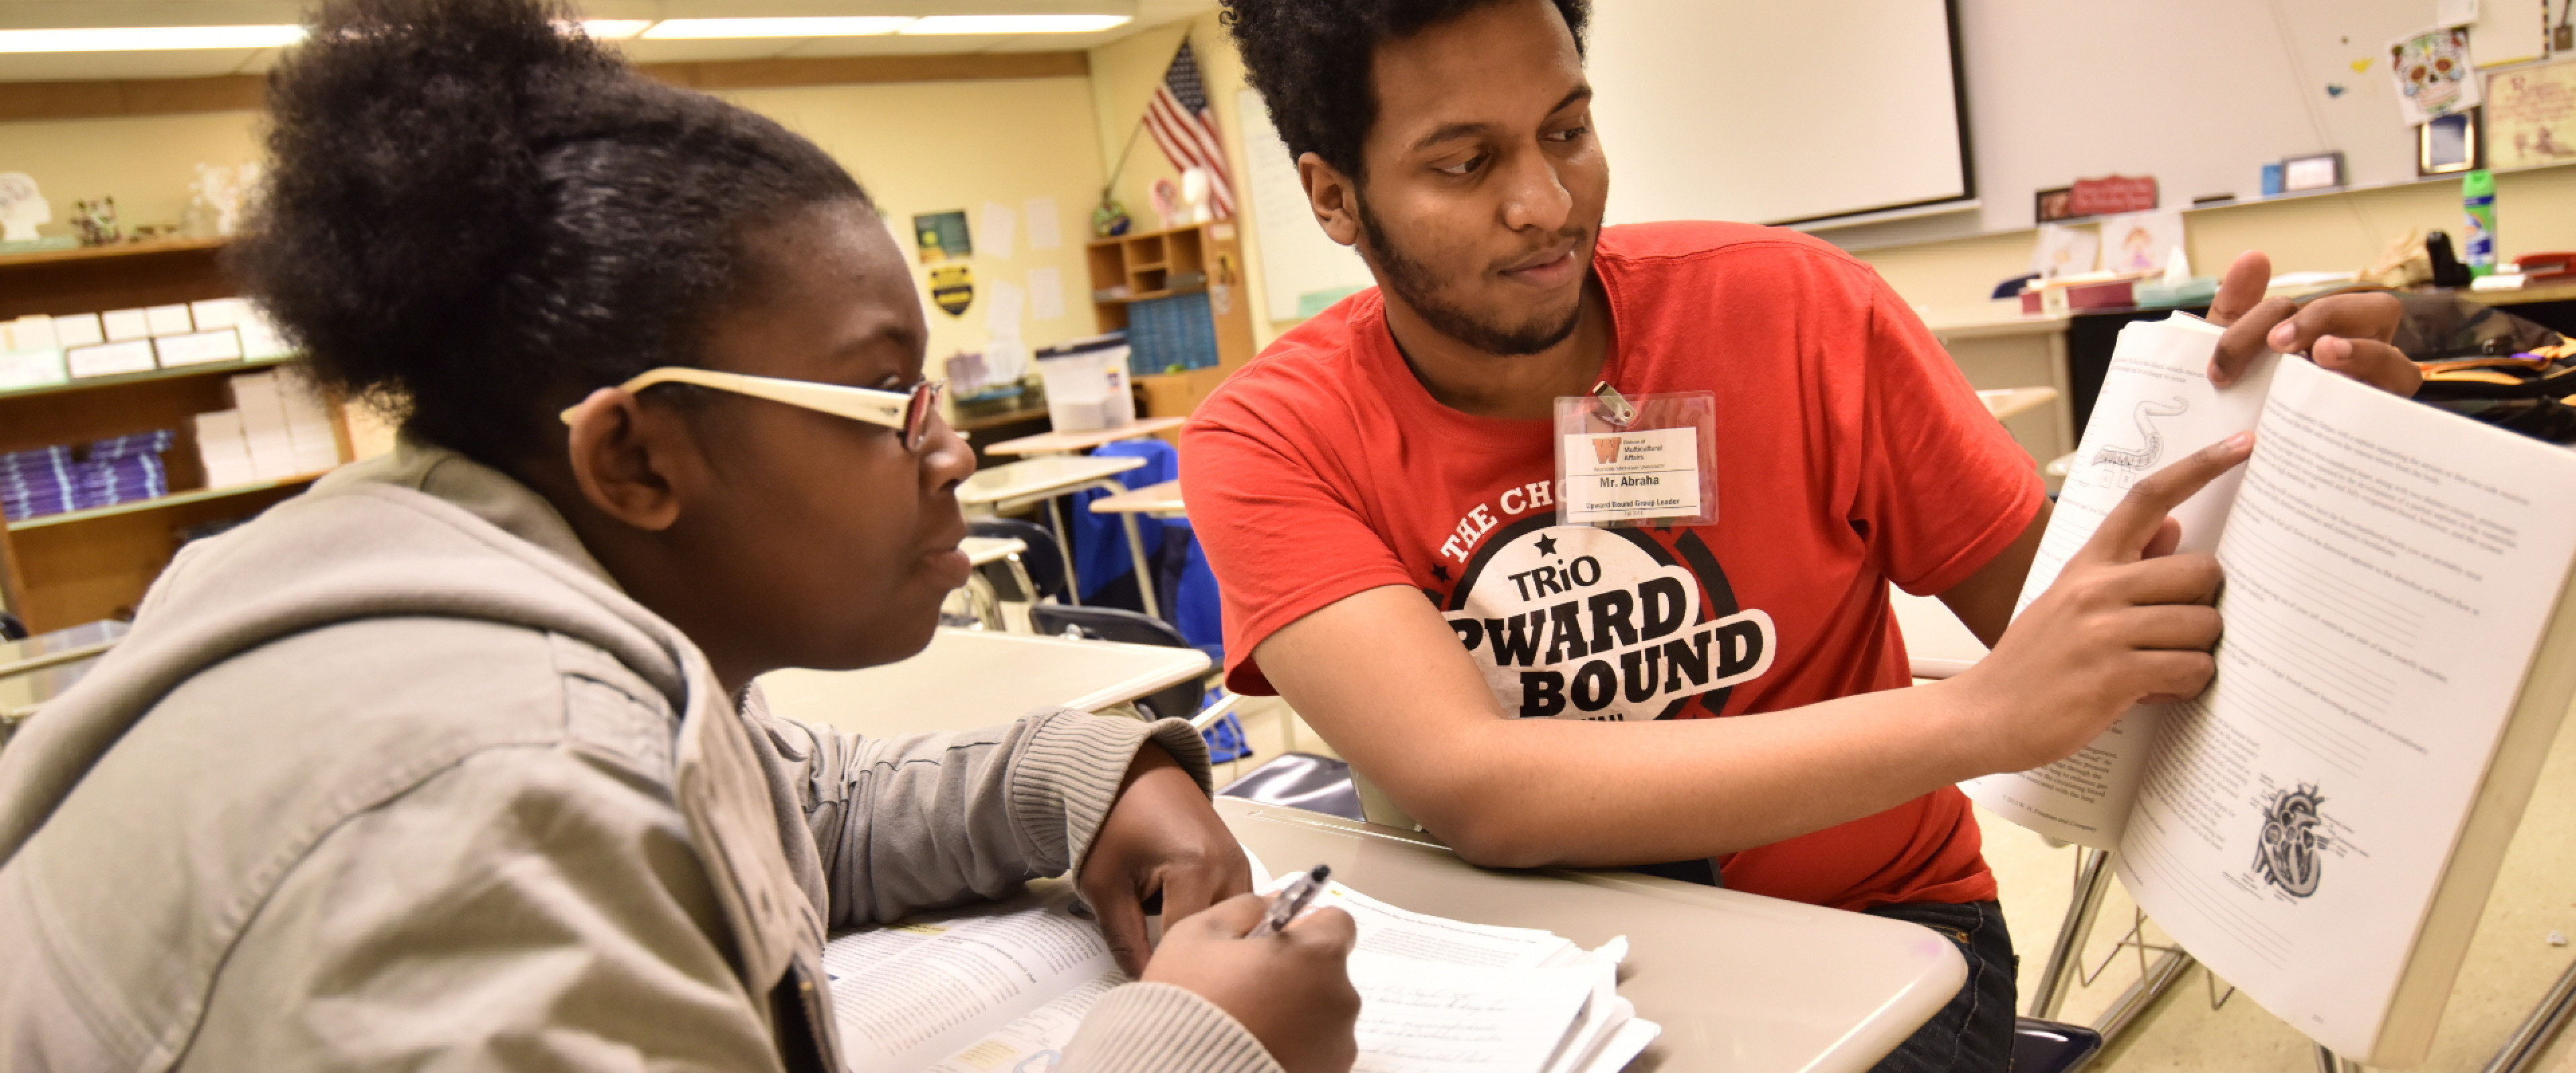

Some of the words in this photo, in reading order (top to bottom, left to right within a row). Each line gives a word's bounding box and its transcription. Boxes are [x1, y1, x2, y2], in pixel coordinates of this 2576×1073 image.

[1600, 477, 1618, 488] Mr.
[1621, 475, 1659, 487] Abraha
[1635, 499, 1655, 508] Group
[1440, 503, 1498, 563] THE
[1508, 555, 1601, 602] TRiO
[1448, 575, 1687, 666] PWARD
[1519, 619, 1764, 718] BOUND
